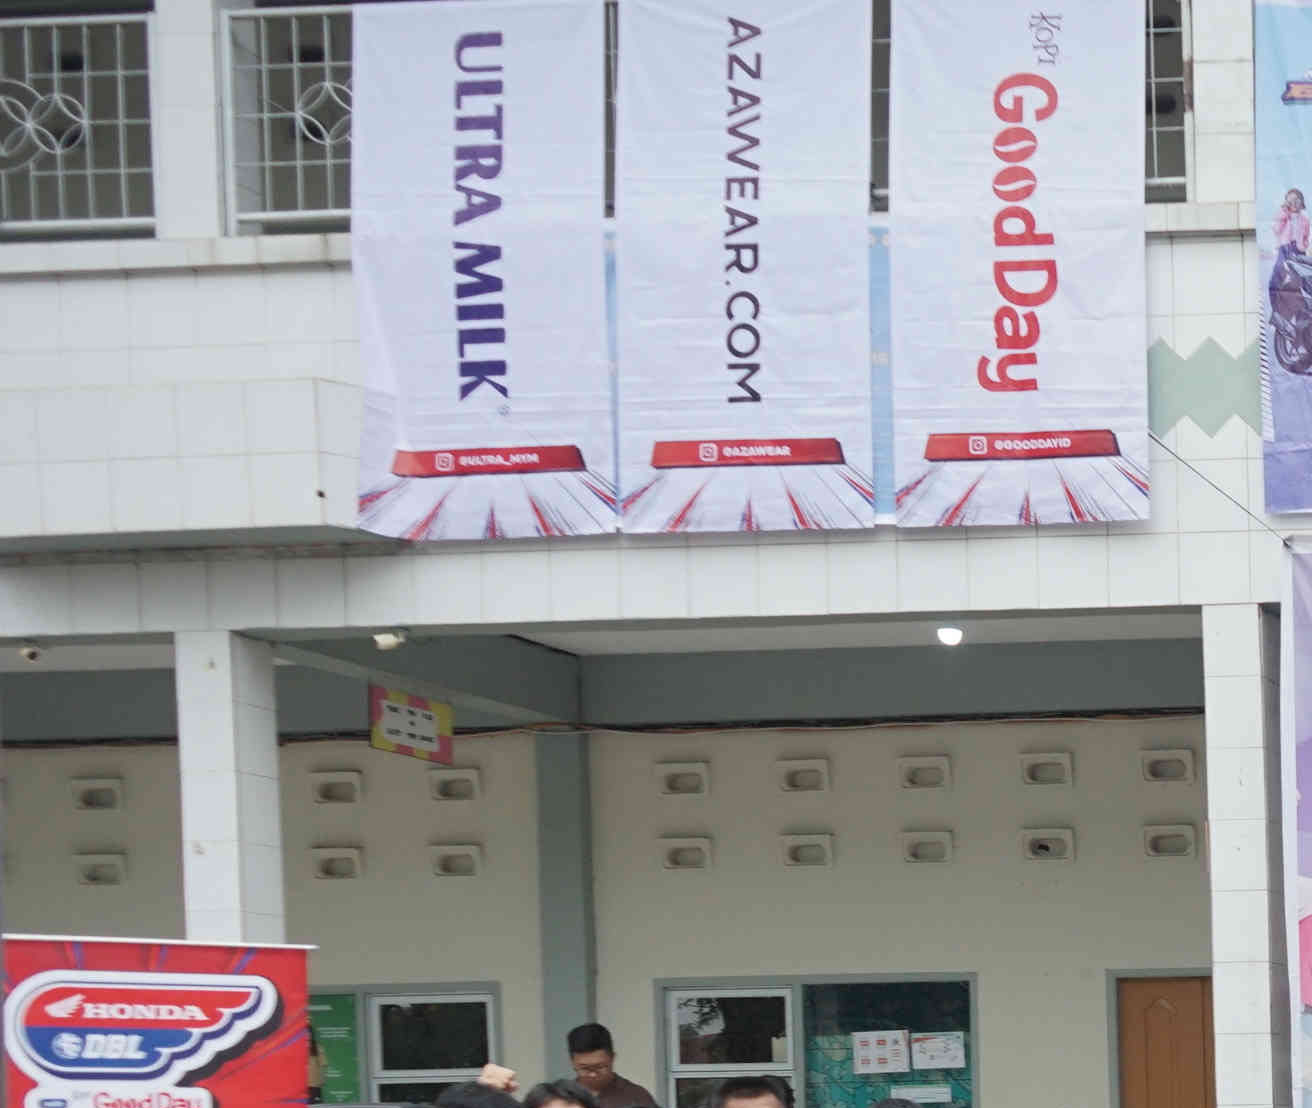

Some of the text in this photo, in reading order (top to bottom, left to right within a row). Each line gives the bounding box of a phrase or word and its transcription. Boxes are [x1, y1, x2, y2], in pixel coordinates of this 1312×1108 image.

[453, 31, 510, 401] ULTRA MILK
[724, 17, 762, 404] AZAWEAR.COM
[976, 72, 1059, 392] Good Day
[81, 1002, 209, 1021] HONDA
[82, 1033, 147, 1060] DBL
